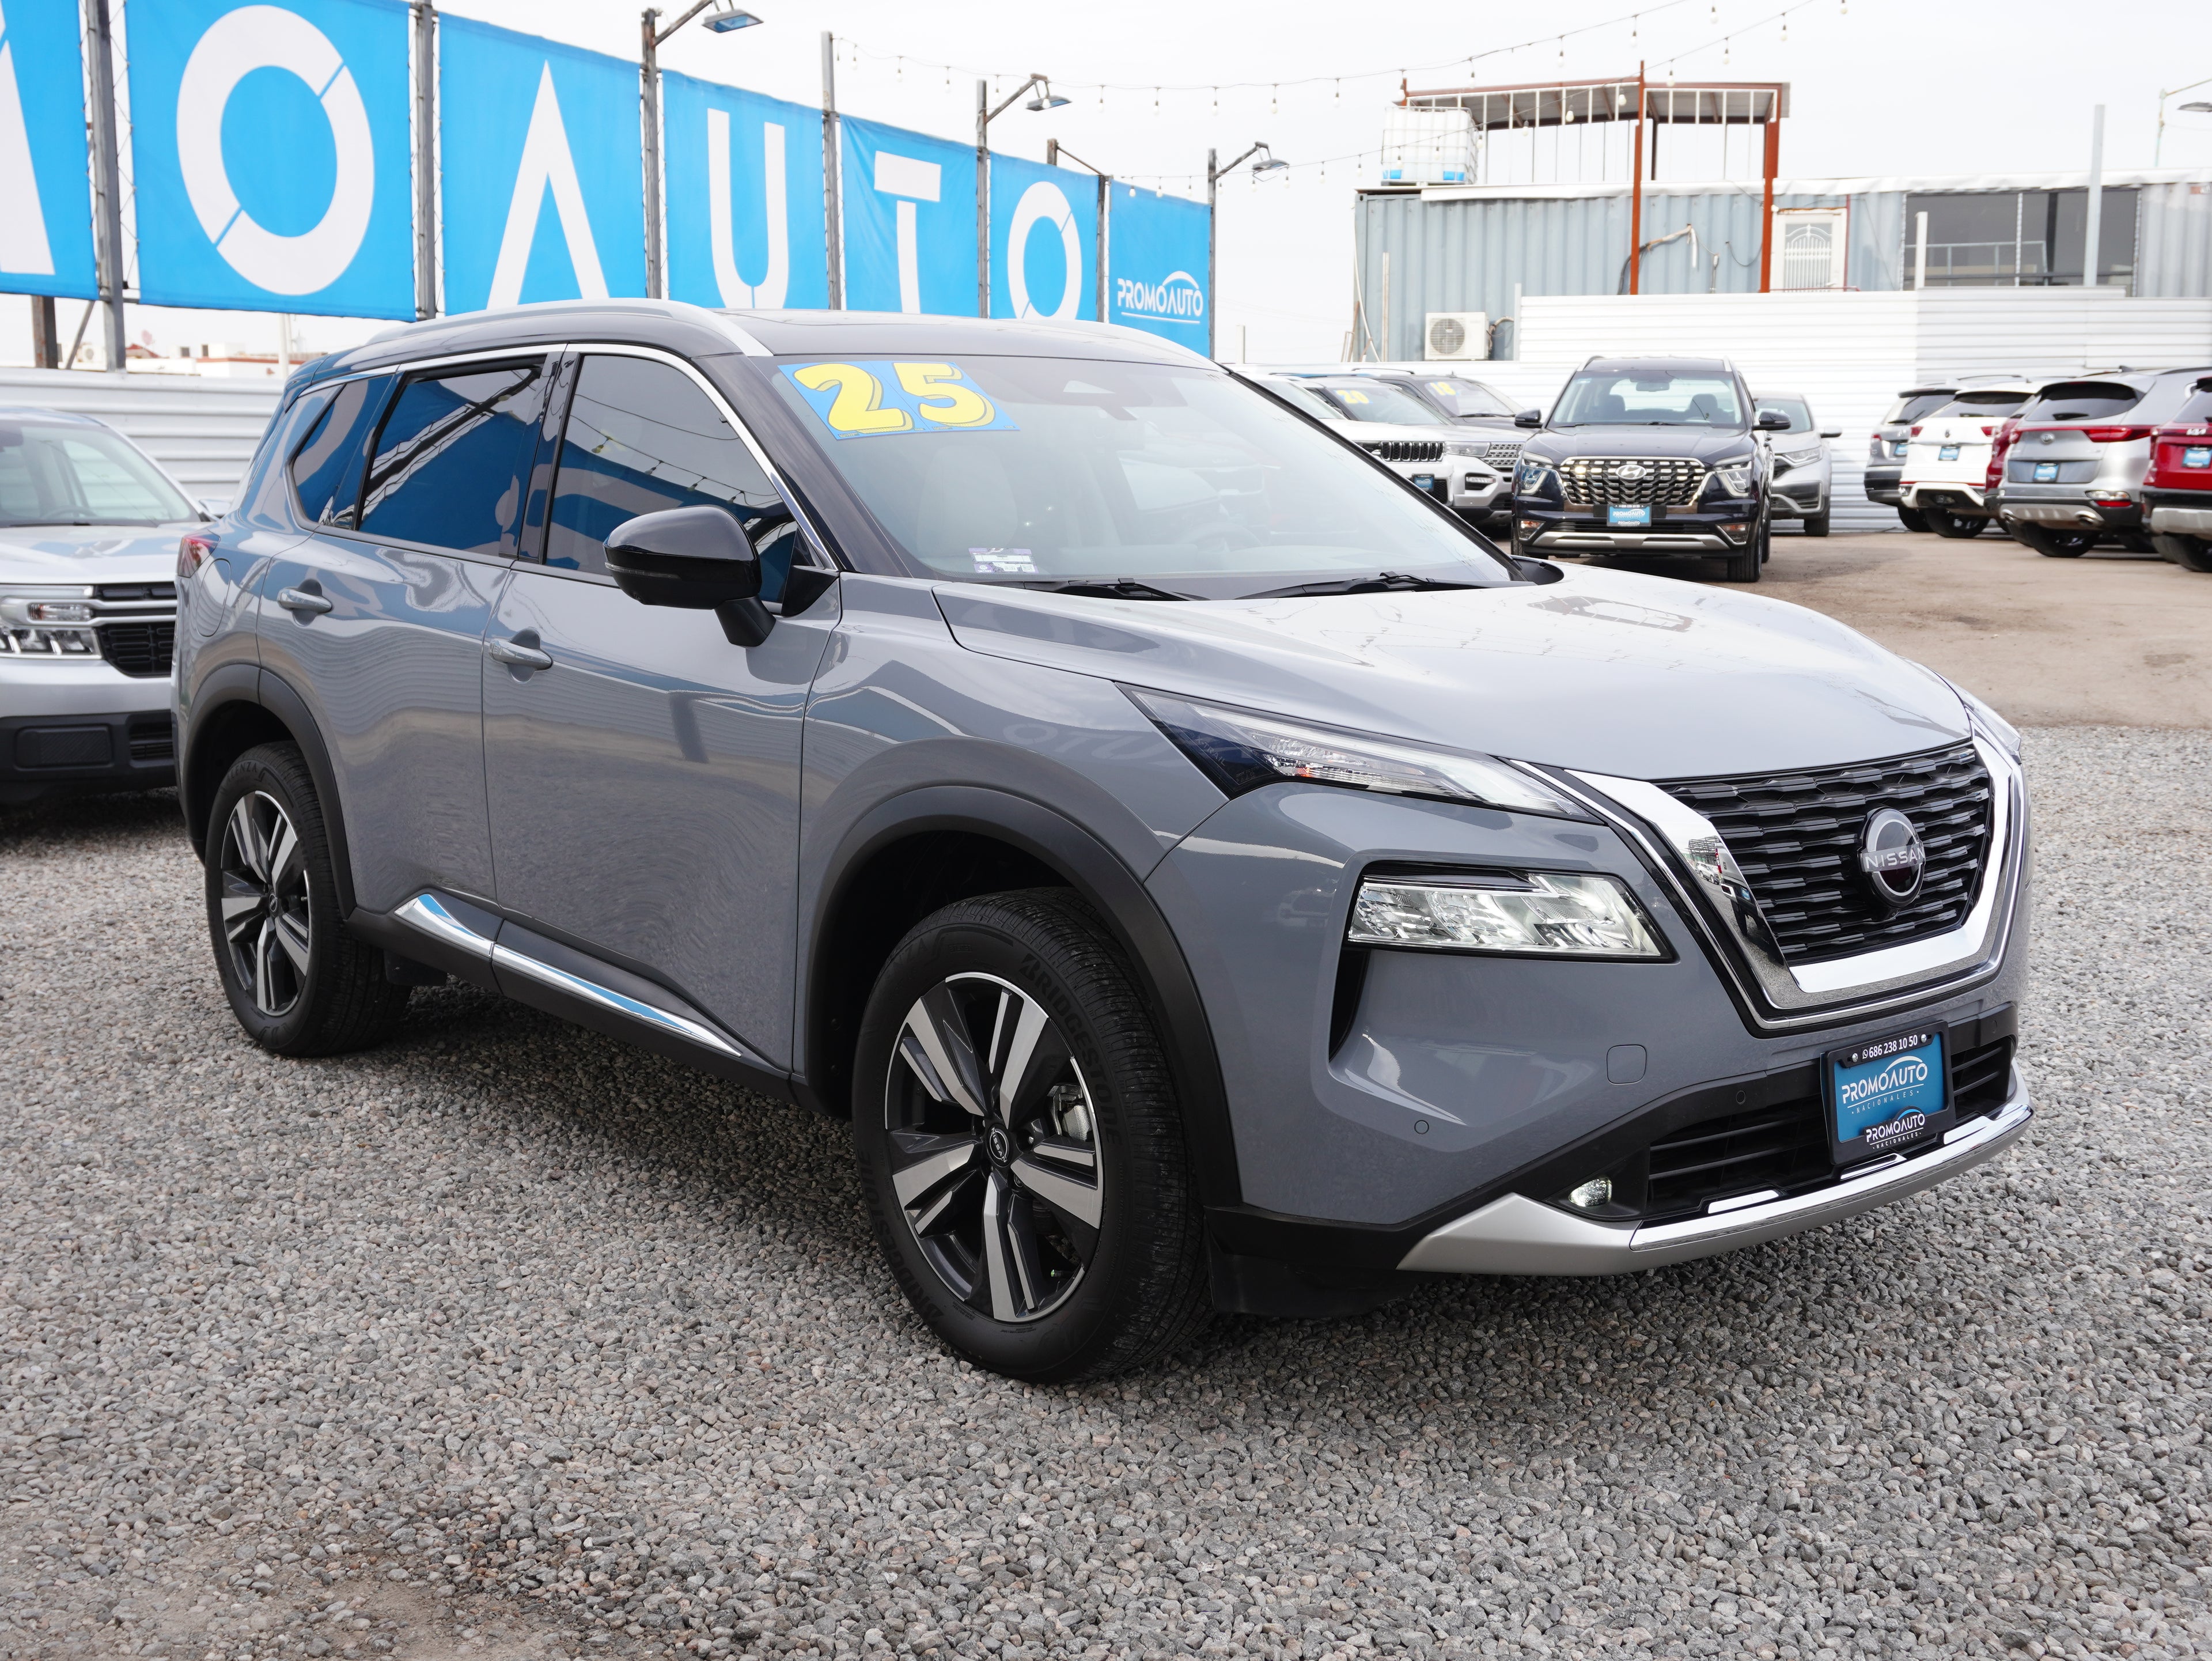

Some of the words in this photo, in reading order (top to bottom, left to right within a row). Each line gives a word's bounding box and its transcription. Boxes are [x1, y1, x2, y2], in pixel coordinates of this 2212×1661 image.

[1118, 278, 1203, 316] PROMOAUTO
[793, 362, 995, 433] 25
[1336, 389, 1370, 404] 20
[1195, 736, 1226, 767] X-TRAIL
[1865, 846, 1926, 869] NISSAN
[1018, 952, 1123, 1147] BRIDGESTONE
[1869, 1047, 1883, 1058] 686
[1884, 1041, 1897, 1054] 238
[1899, 1037, 1908, 1050] 10
[1908, 1034, 1918, 1047] 50
[1842, 1062, 1928, 1104] PROMOAUTO
[1856, 1090, 1914, 1114] NACIONALES
[1866, 1113, 1926, 1143] PROMOAUTO
[1876, 1132, 1918, 1149] NACIONALES
[991, 1127, 1007, 1163] NISSAN
[857, 1148, 945, 1325] BRIDGESTONE
